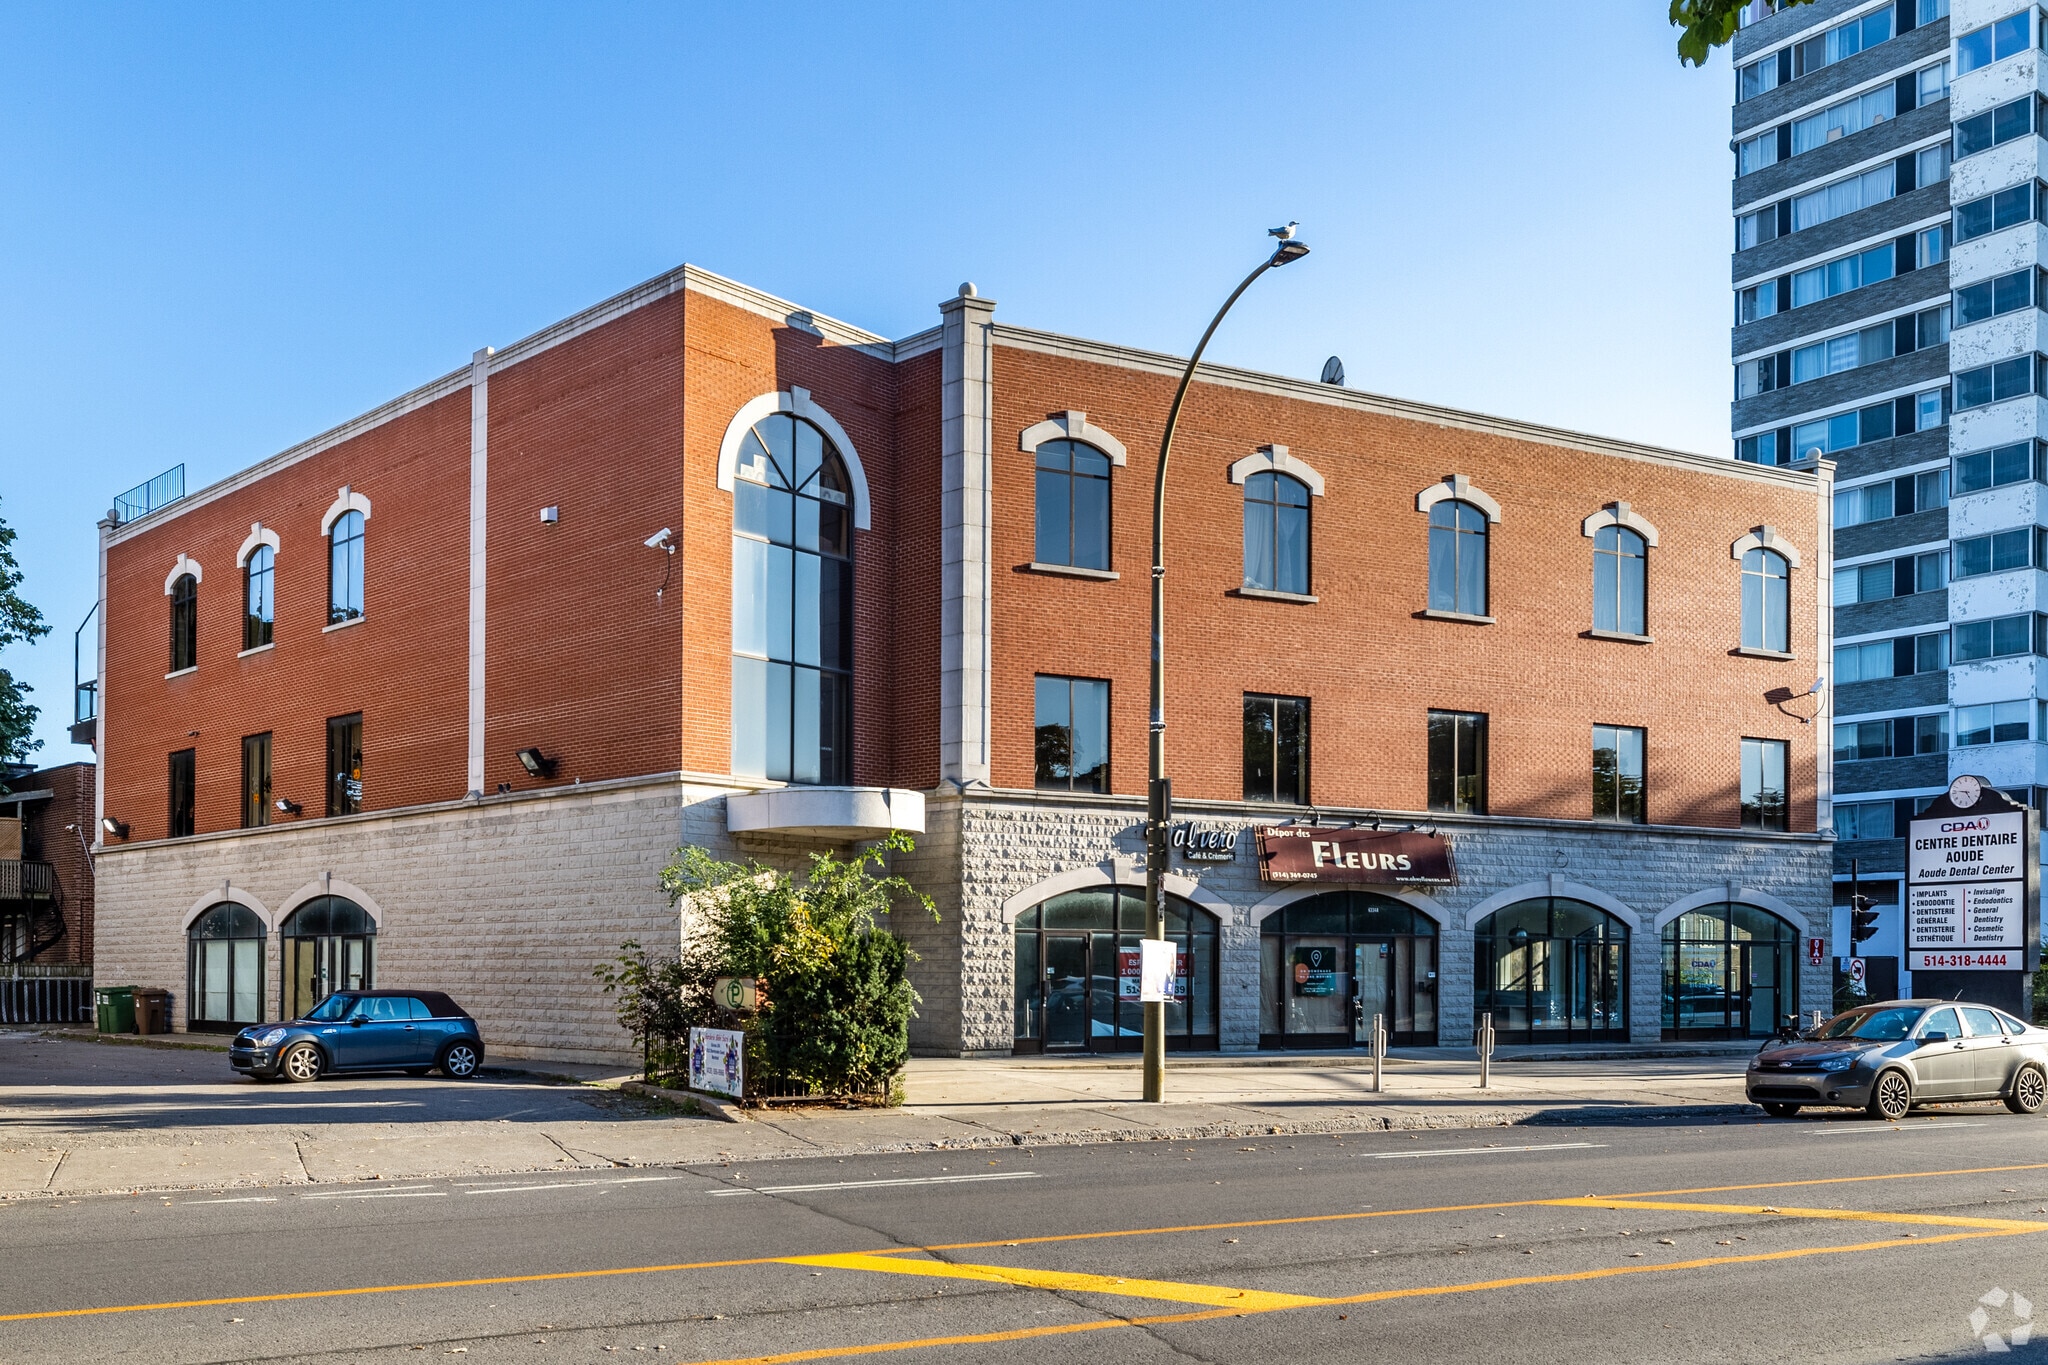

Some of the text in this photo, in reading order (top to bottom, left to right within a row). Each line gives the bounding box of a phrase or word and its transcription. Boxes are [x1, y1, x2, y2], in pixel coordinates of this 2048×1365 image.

[1296, 829, 1310, 838] des
[1941, 822, 1976, 832] CDA
[1146, 822, 1236, 849] alvero
[1916, 833, 2017, 850] CENTRE DENTAIRE
[1946, 850, 1984, 863] AOUDE
[1919, 864, 2015, 878] Aoude Dental Center
[1924, 955, 2007, 966] 514-318-4444
